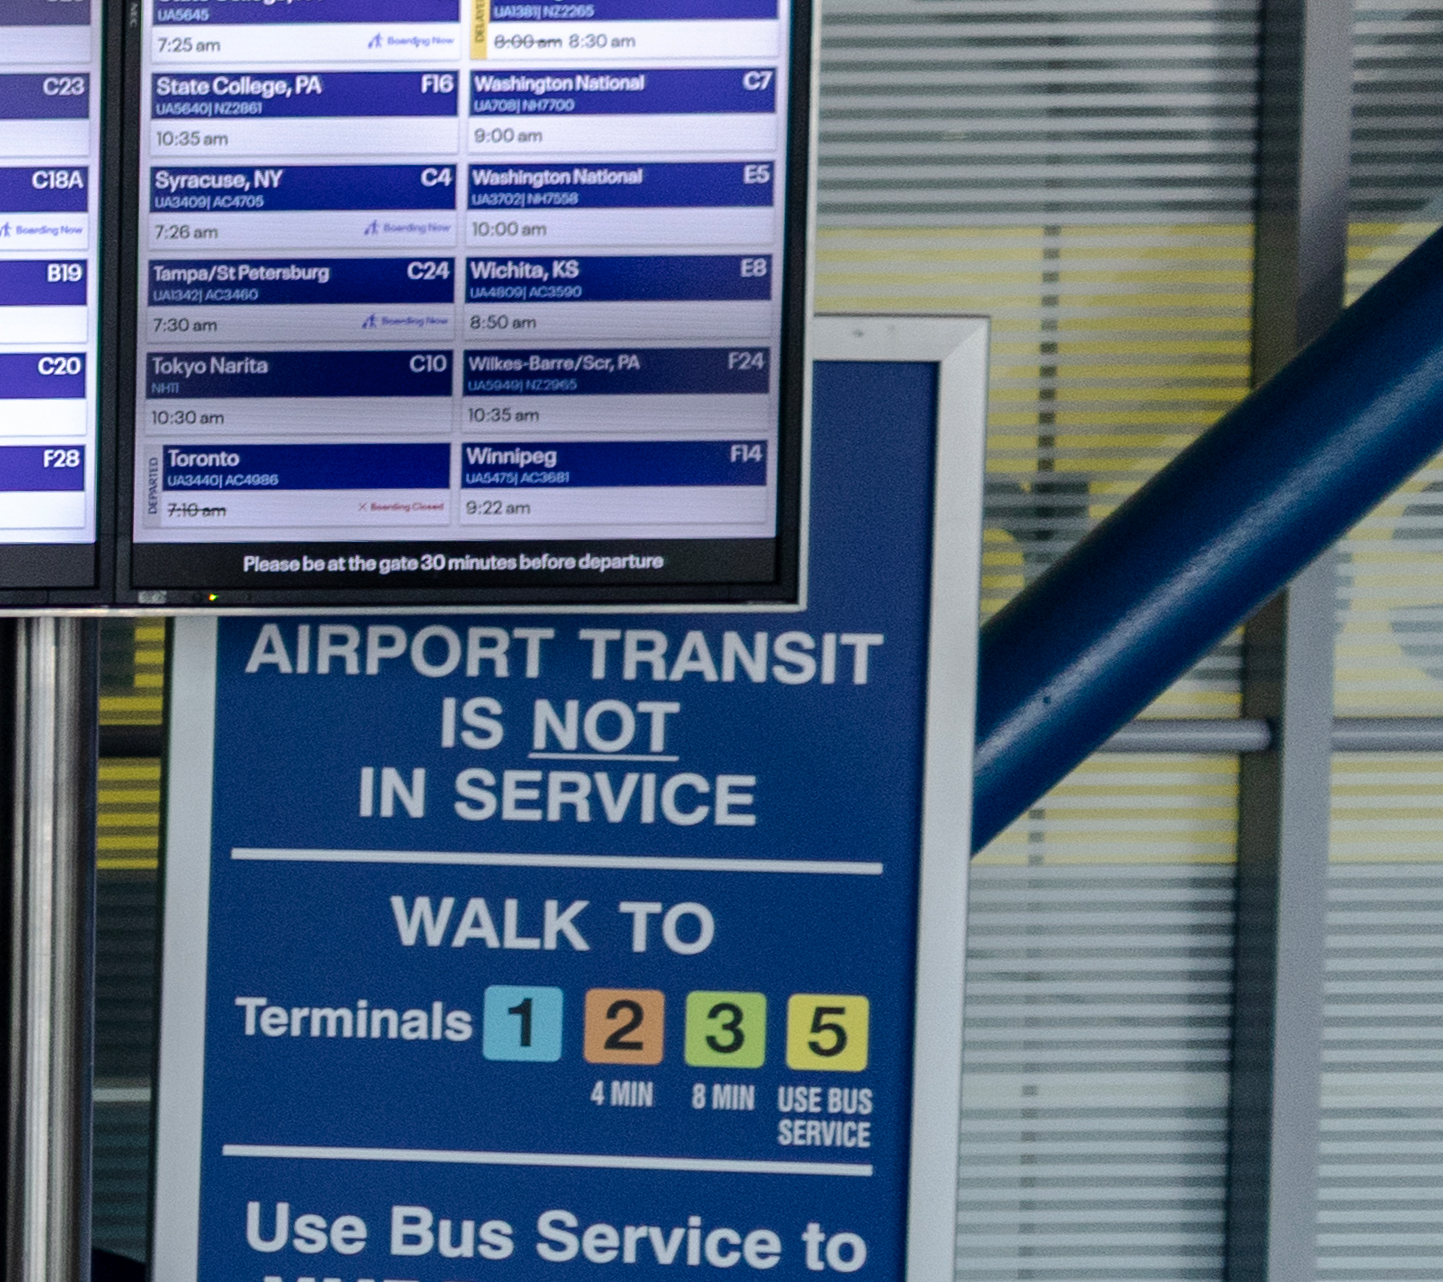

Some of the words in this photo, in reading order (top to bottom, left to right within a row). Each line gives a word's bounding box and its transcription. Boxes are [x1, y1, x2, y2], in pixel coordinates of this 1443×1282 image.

[39, 357, 80, 374] C20
[153, 357, 206, 378] Tokyo
[211, 357, 268, 373] Narita
[410, 355, 447, 372] C10
[246, 625, 554, 677] AIRPORT
[580, 630, 883, 684] TRANSIT
[443, 698, 502, 748] IS
[535, 700, 679, 751] NOT
[361, 768, 424, 817] IN
[455, 769, 755, 825] SERVICE
[391, 896, 589, 950] WALK
[620, 902, 714, 954] TO
[236, 997, 472, 1041] Terminals
[509, 998, 532, 1047] 1
[605, 1000, 643, 1050] 2
[706, 1003, 744, 1053] 3
[809, 1007, 847, 1057] 5
[591, 1081, 604, 1105] 4
[613, 1081, 654, 1108] MIN
[693, 1084, 705, 1108] 8
[714, 1084, 755, 1111] MIN
[778, 1086, 821, 1113] USE
[827, 1087, 872, 1115] BUS
[778, 1118, 872, 1147] SERVICE
[247, 1202, 366, 1254] Use
[392, 1206, 513, 1259] Bus
[537, 1210, 781, 1269] Service
[803, 1223, 866, 1272] to
